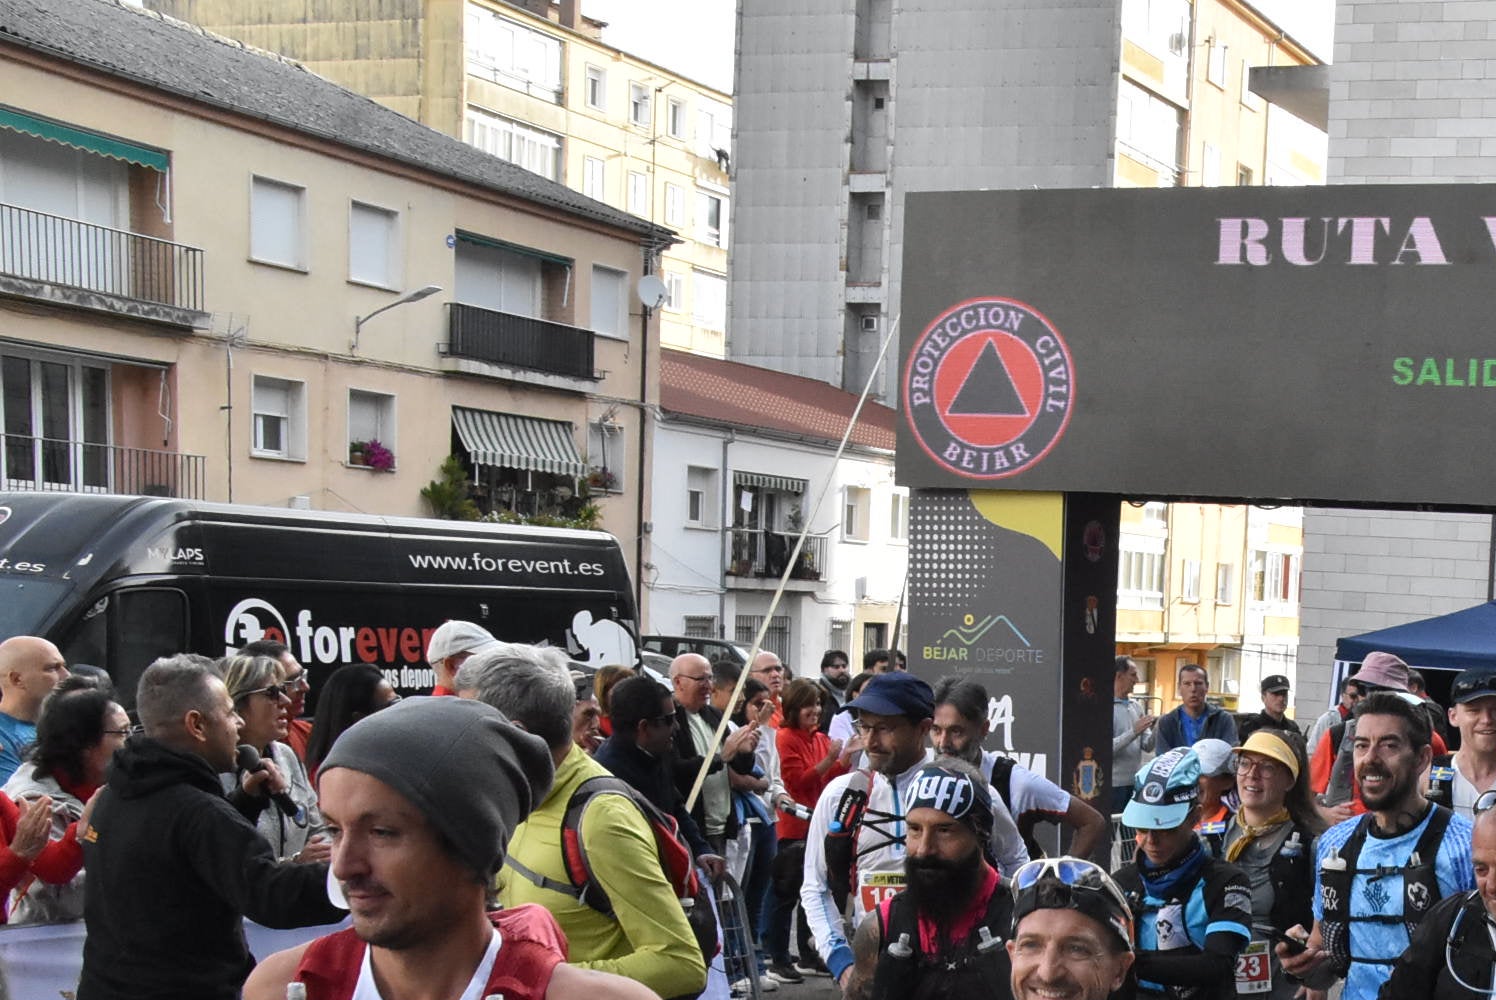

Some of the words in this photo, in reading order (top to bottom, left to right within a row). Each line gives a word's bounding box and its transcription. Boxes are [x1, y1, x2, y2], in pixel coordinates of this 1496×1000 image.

[1214, 216, 1453, 265] RUTA
[912, 307, 1025, 407] PROTECCION
[1035, 335, 1067, 413] CIVIL
[943, 442, 1031, 472] BEJAR
[408, 552, 605, 576] www.forevent.es
[975, 647, 1044, 664] DEPORTE
[1235, 956, 1261, 977] 23
